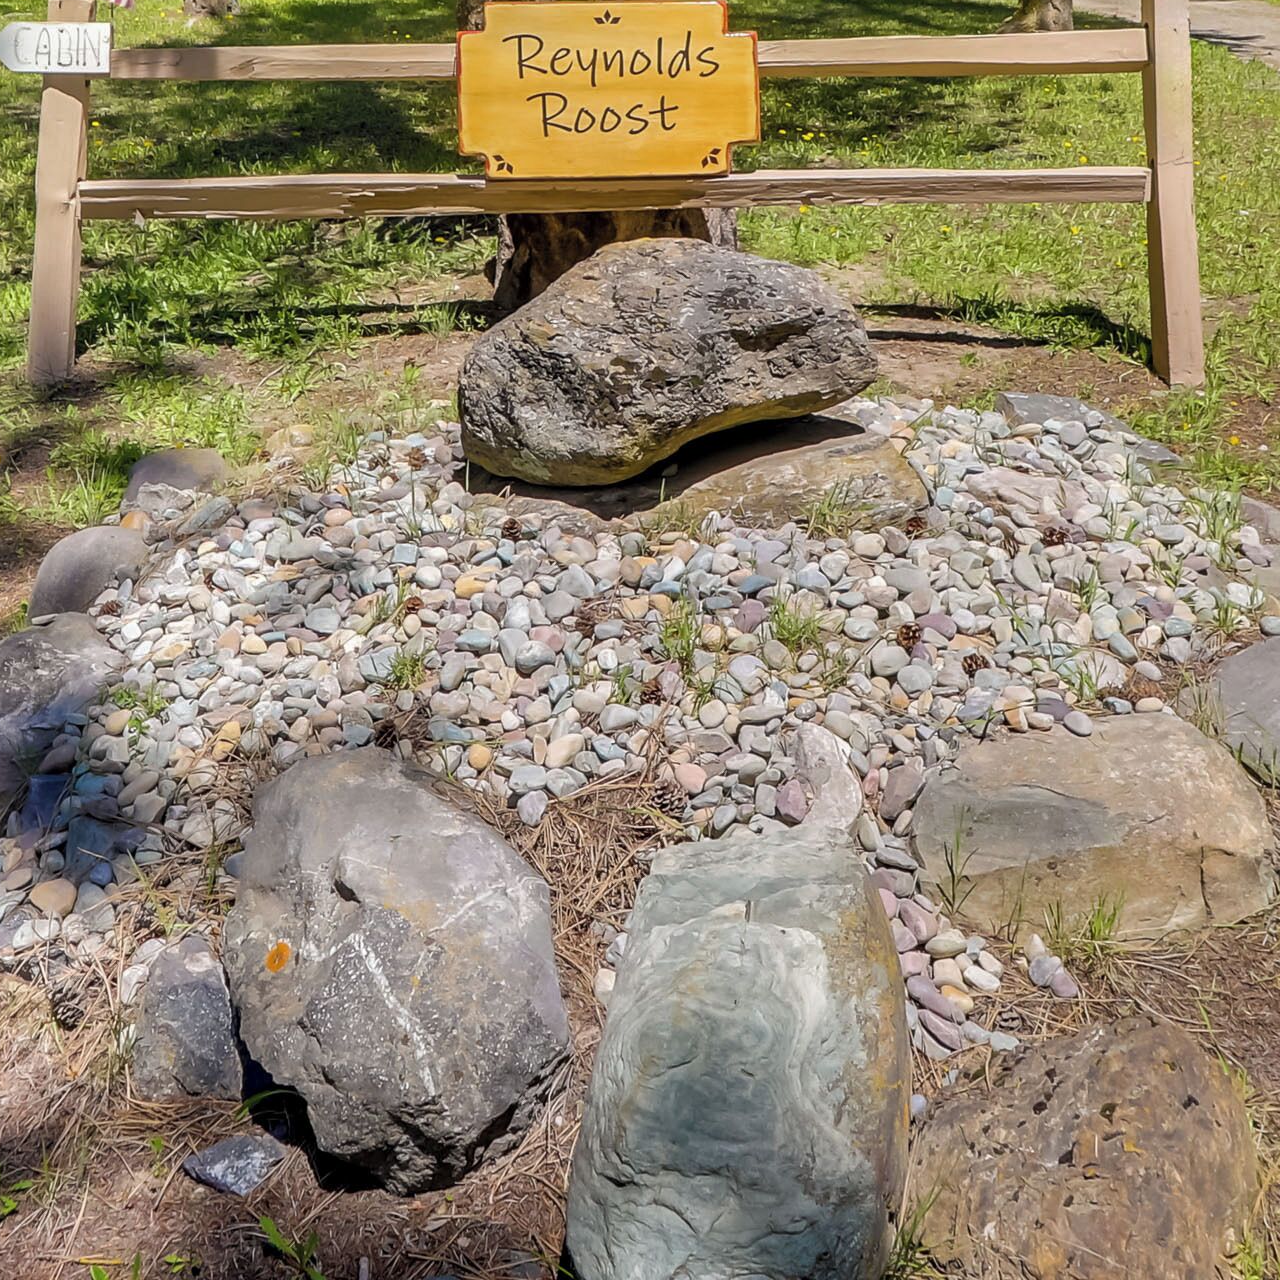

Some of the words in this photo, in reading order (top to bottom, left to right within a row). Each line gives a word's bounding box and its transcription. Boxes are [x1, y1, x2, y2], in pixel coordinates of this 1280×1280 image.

[14, 26, 101, 67] CABIN
[501, 30, 720, 87] Reynolds
[526, 91, 680, 138] Roost
